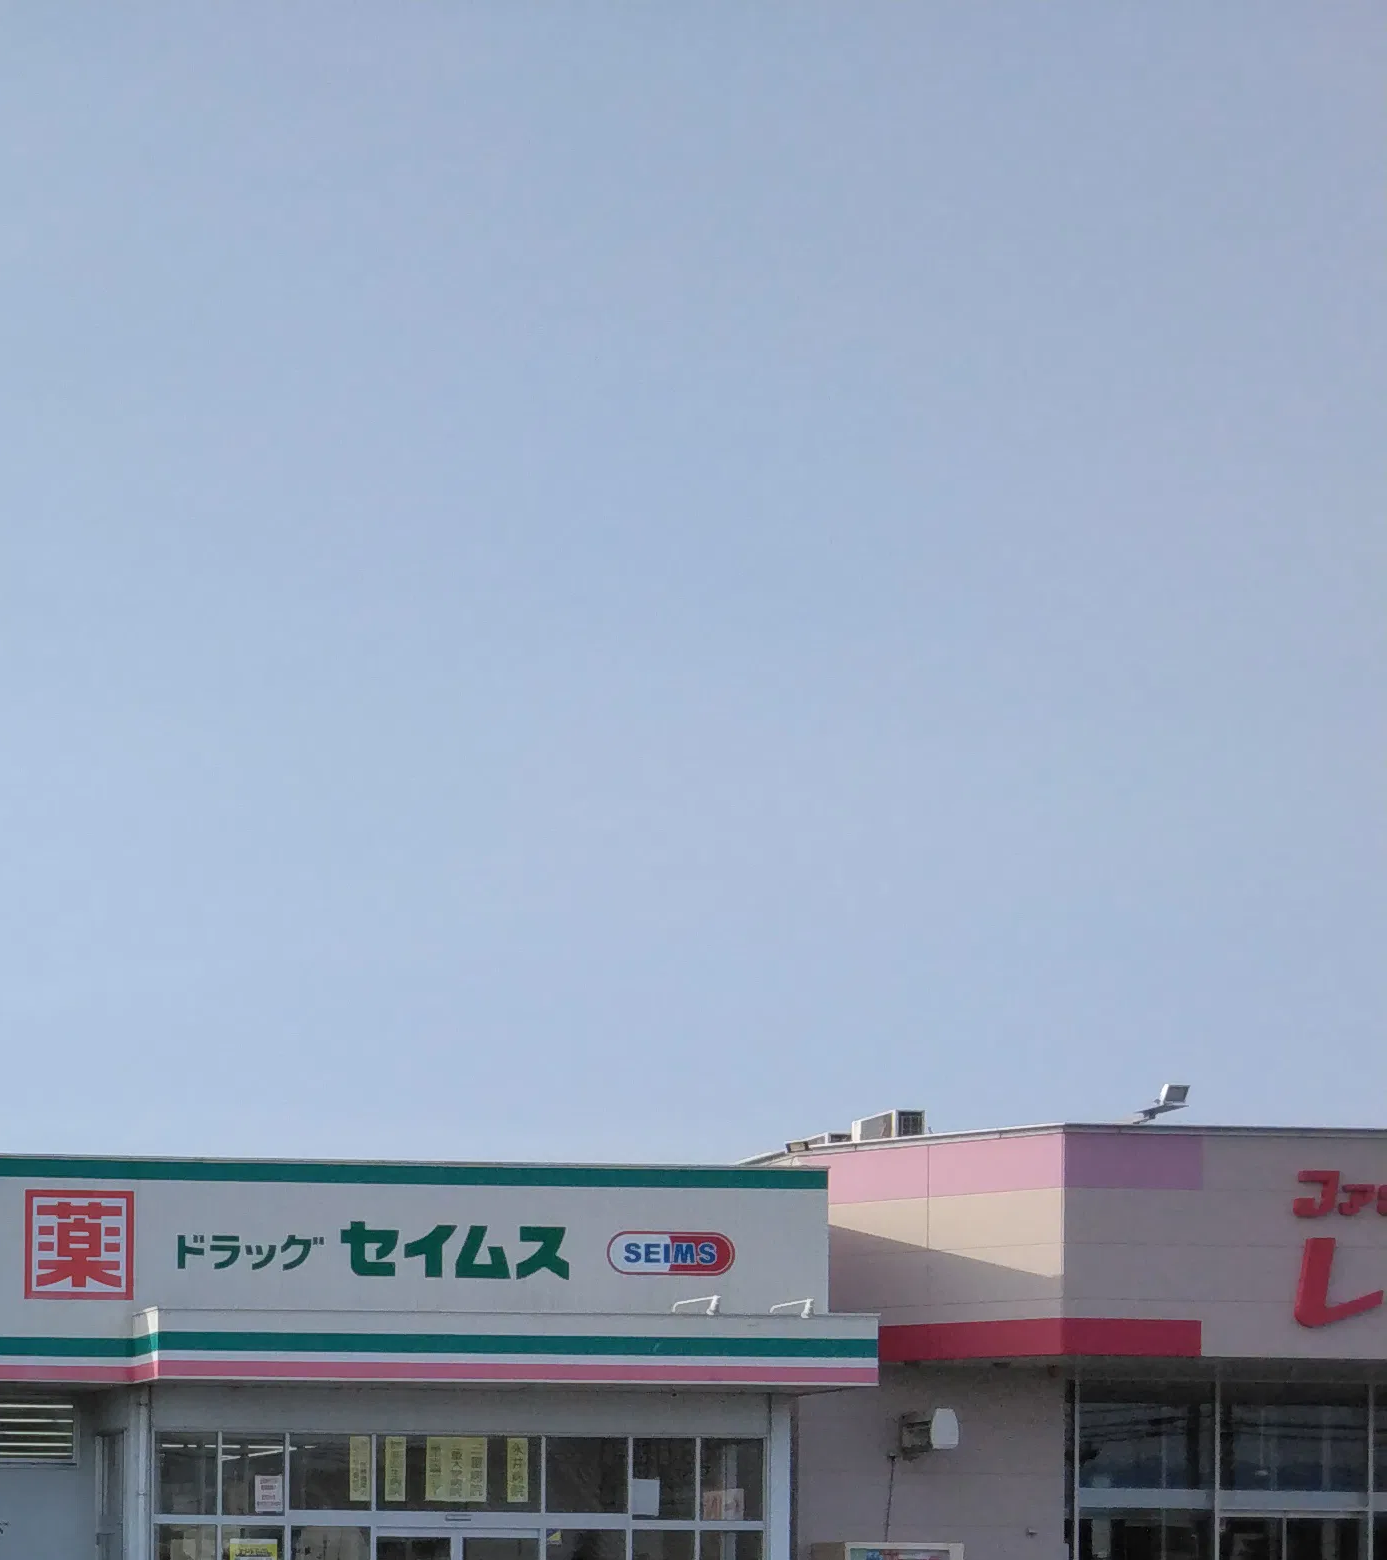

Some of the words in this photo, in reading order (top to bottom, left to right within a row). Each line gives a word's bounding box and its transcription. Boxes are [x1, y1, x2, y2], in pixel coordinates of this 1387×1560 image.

[1293, 1170, 1387, 1218] ファ
[35, 1200, 127, 1288] 薬
[176, 1232, 325, 1271] ドラッグ
[340, 1220, 570, 1281] セイムス
[622, 1242, 717, 1266] SEIMS
